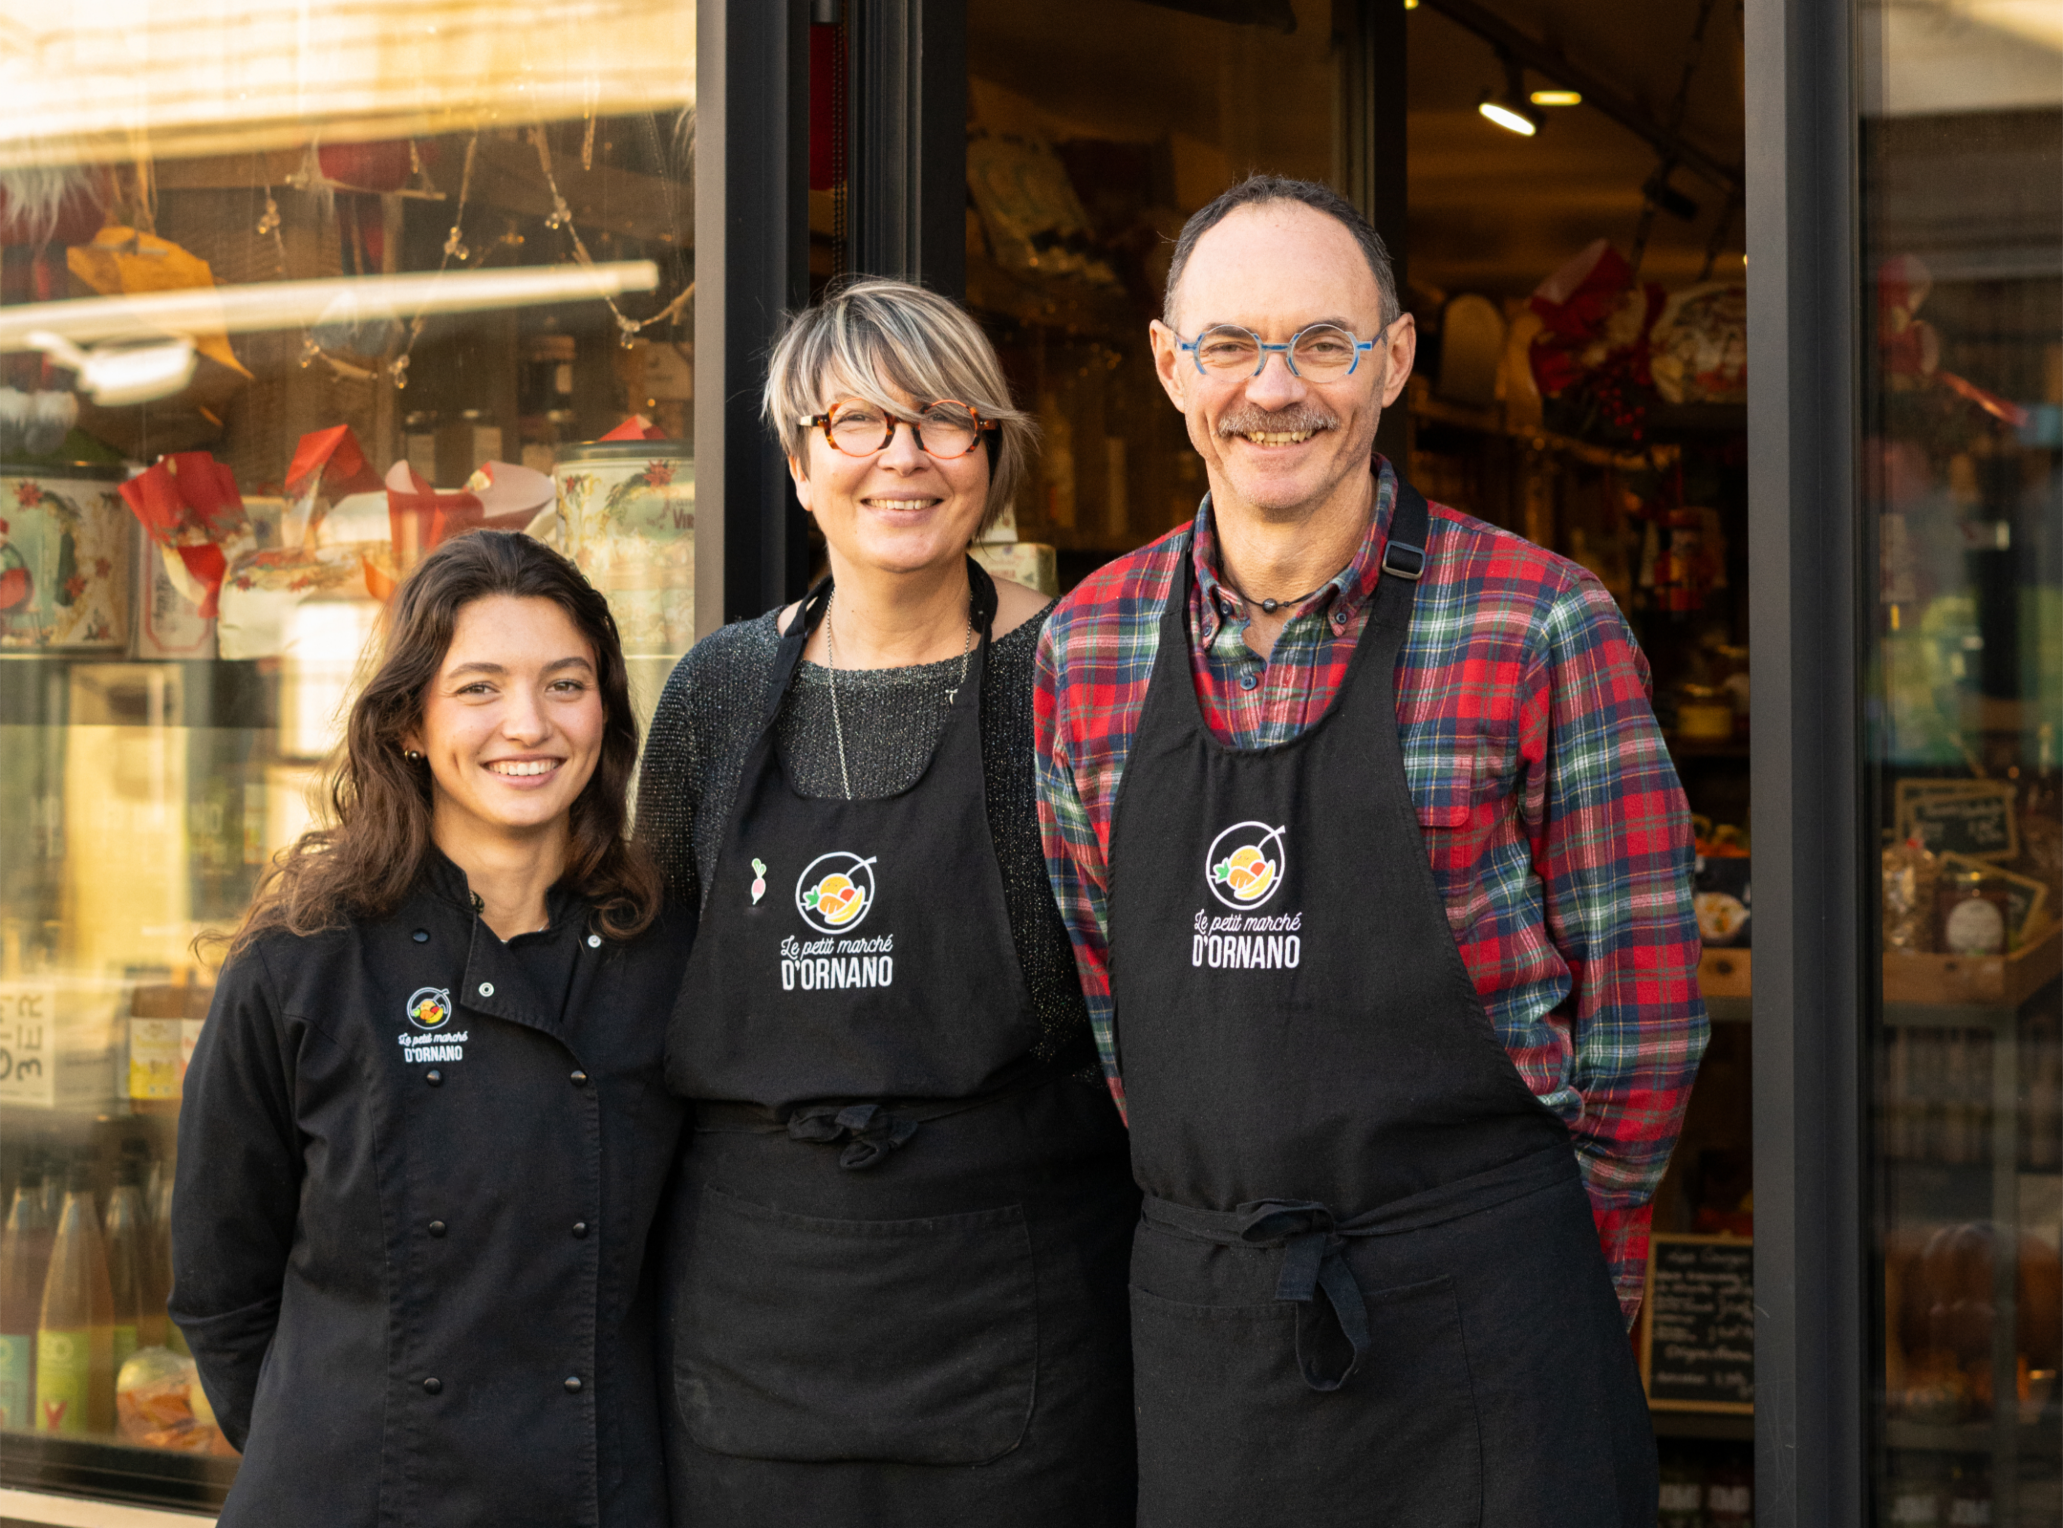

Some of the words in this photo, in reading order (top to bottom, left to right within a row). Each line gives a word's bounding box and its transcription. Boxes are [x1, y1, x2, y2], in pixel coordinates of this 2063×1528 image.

[1194, 908, 1208, 935] Le
[1208, 913, 1242, 936] petit
[1243, 911, 1302, 932] marché
[781, 934, 800, 960] Le
[800, 937, 835, 961] petit
[836, 933, 894, 954] marché
[1192, 934, 1301, 969] D'ORNANO
[781, 956, 893, 991] D'ORNANO
[398, 1032, 411, 1047] Le
[411, 1032, 432, 1047] petit
[433, 1030, 469, 1043] marché
[404, 1045, 463, 1063] D'ORNANO
